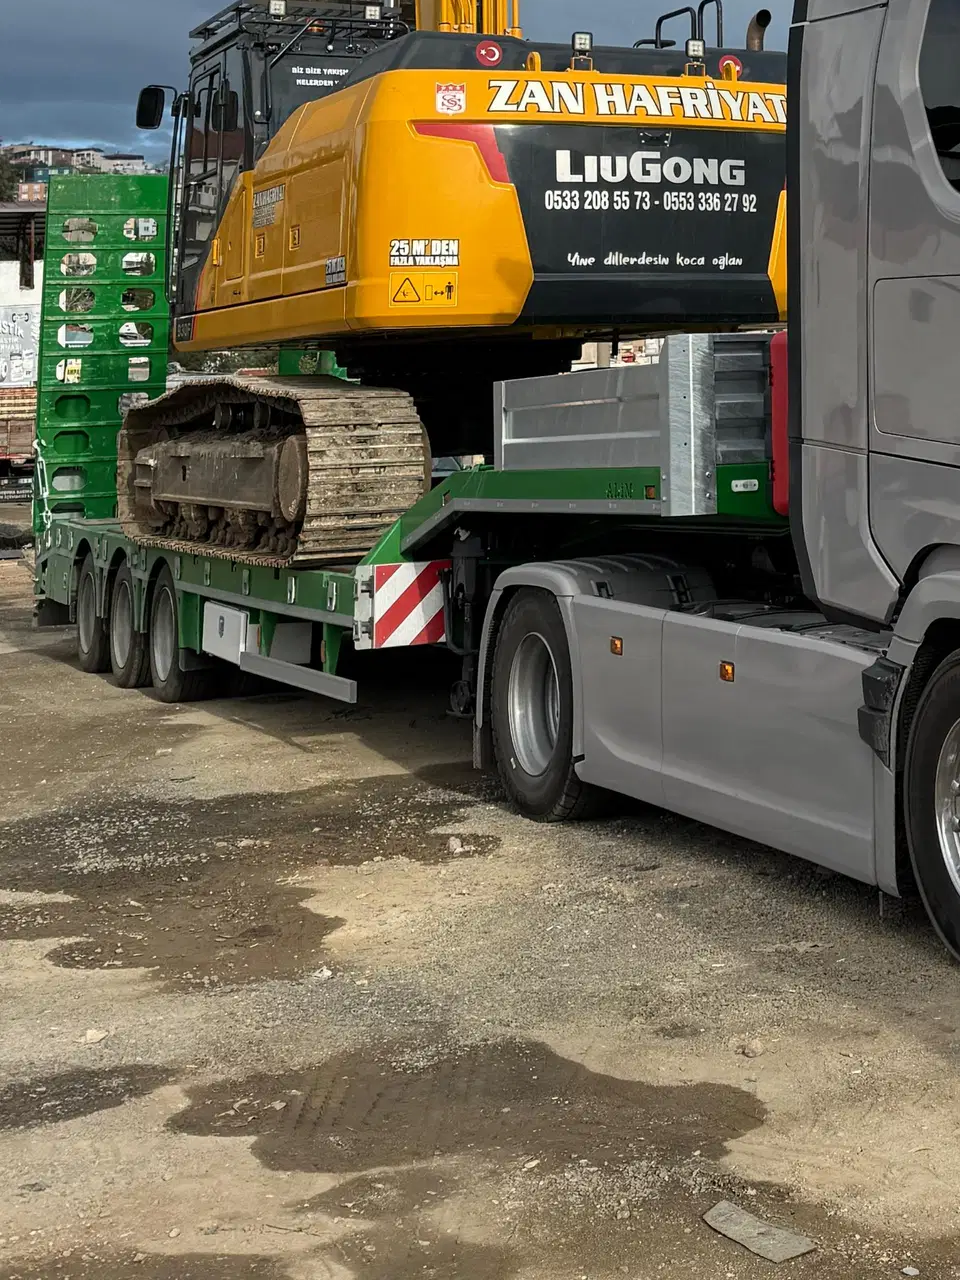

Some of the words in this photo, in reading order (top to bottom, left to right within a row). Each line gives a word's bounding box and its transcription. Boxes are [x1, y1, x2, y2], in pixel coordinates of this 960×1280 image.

[487, 79, 585, 115] ZAN
[591, 81, 788, 124] HAFRİYAT
[544, 190, 580, 210] 0533
[583, 191, 610, 210] 208
[613, 191, 630, 210] 55
[633, 191, 651, 210] 73
[663, 192, 695, 211] 0553
[698, 192, 721, 211] 336
[724, 193, 739, 212] 27
[742, 193, 758, 213] 92
[390, 239, 410, 256] 25
[431, 239, 459, 256] DEN
[390, 255, 415, 266] FAZLA
[414, 255, 459, 268] YAKLAŞMA
[603, 252, 670, 266] dillerdesin
[676, 252, 705, 266] koca
[712, 253, 743, 270] oğlan
